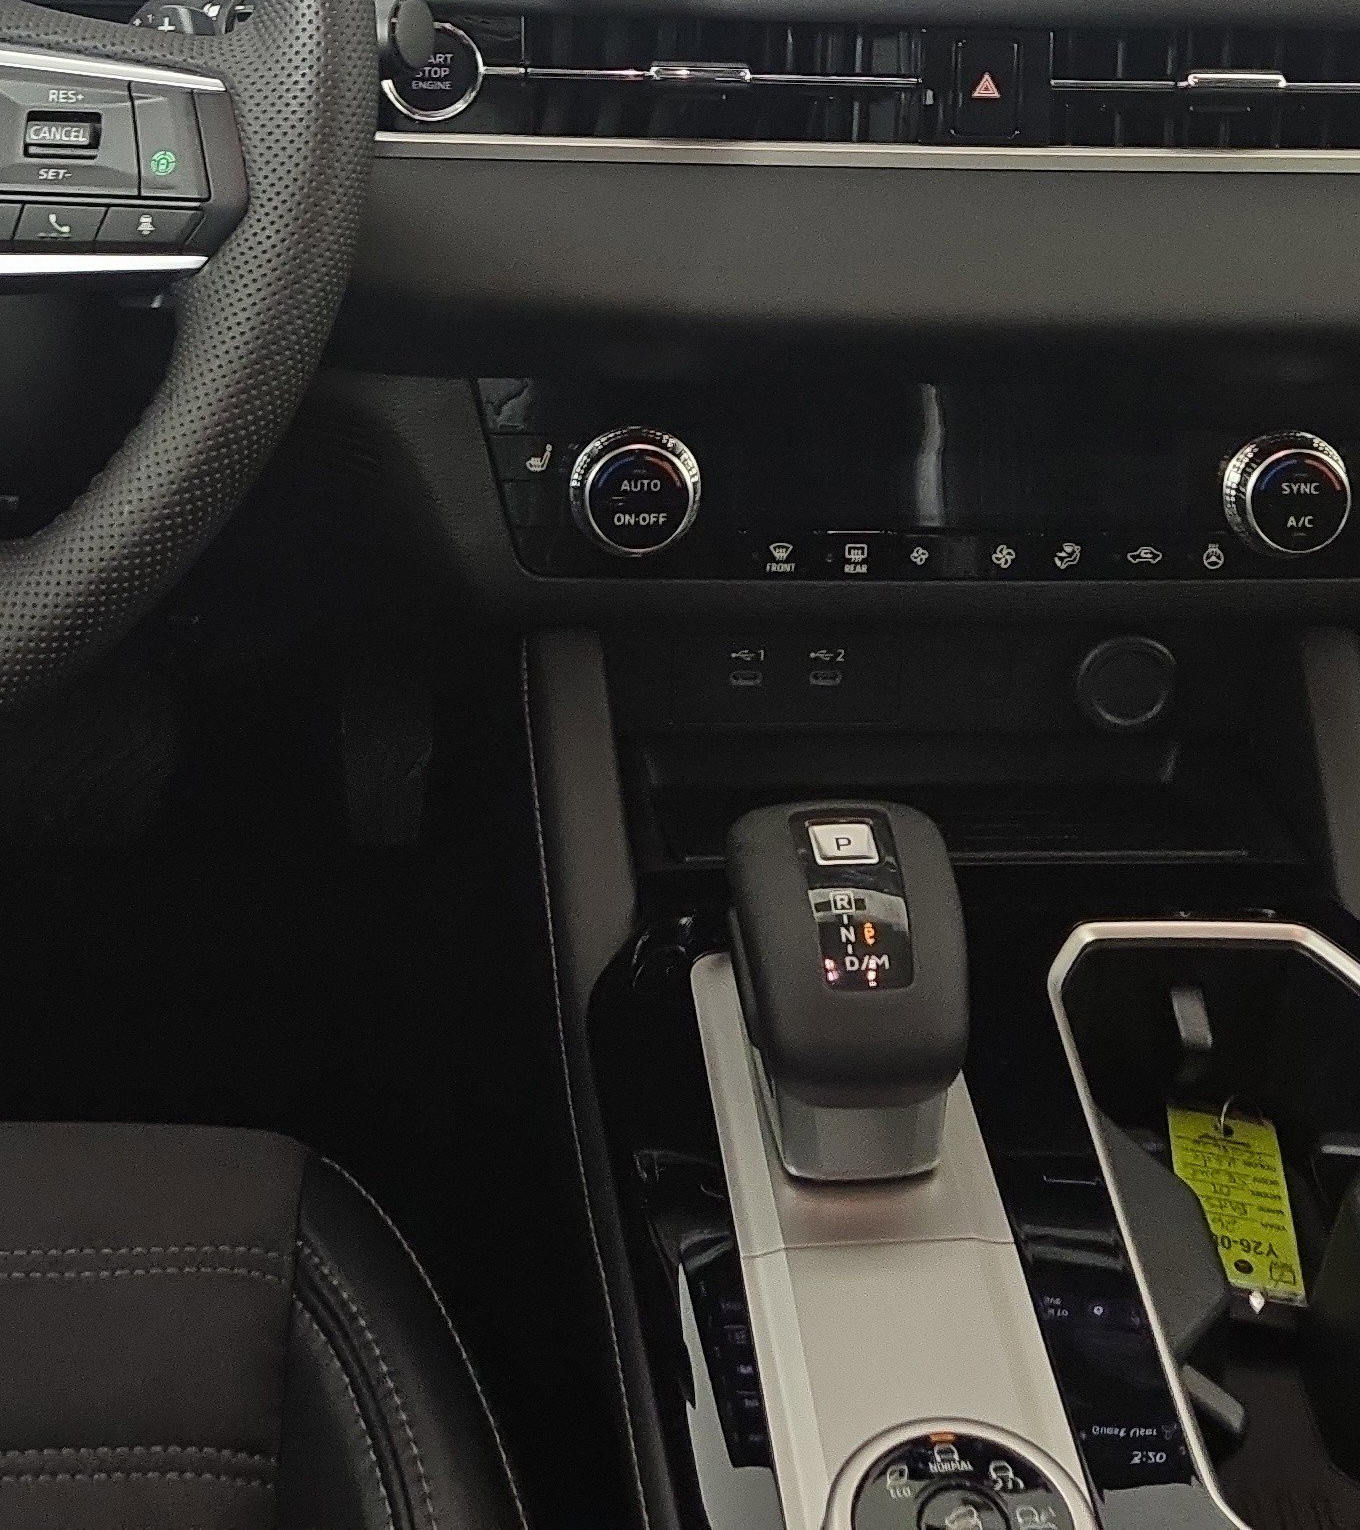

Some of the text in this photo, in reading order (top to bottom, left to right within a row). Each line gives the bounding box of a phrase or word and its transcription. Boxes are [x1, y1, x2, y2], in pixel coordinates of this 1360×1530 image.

[412, 81, 452, 90] ENGINE
[48, 90, 84, 102] RES+
[29, 125, 88, 142] CANCEL
[620, 479, 661, 492] AUTO
[1281, 483, 1320, 495] SYNC
[1286, 515, 1314, 529] A/C
[766, 562, 796, 573] FRONT
[844, 563, 868, 574] REAR
[835, 649, 845, 661] 2
[835, 837, 851, 851] P
[834, 895, 850, 909] R
[840, 926, 855, 942] N
[844, 955, 890, 971] D/M
